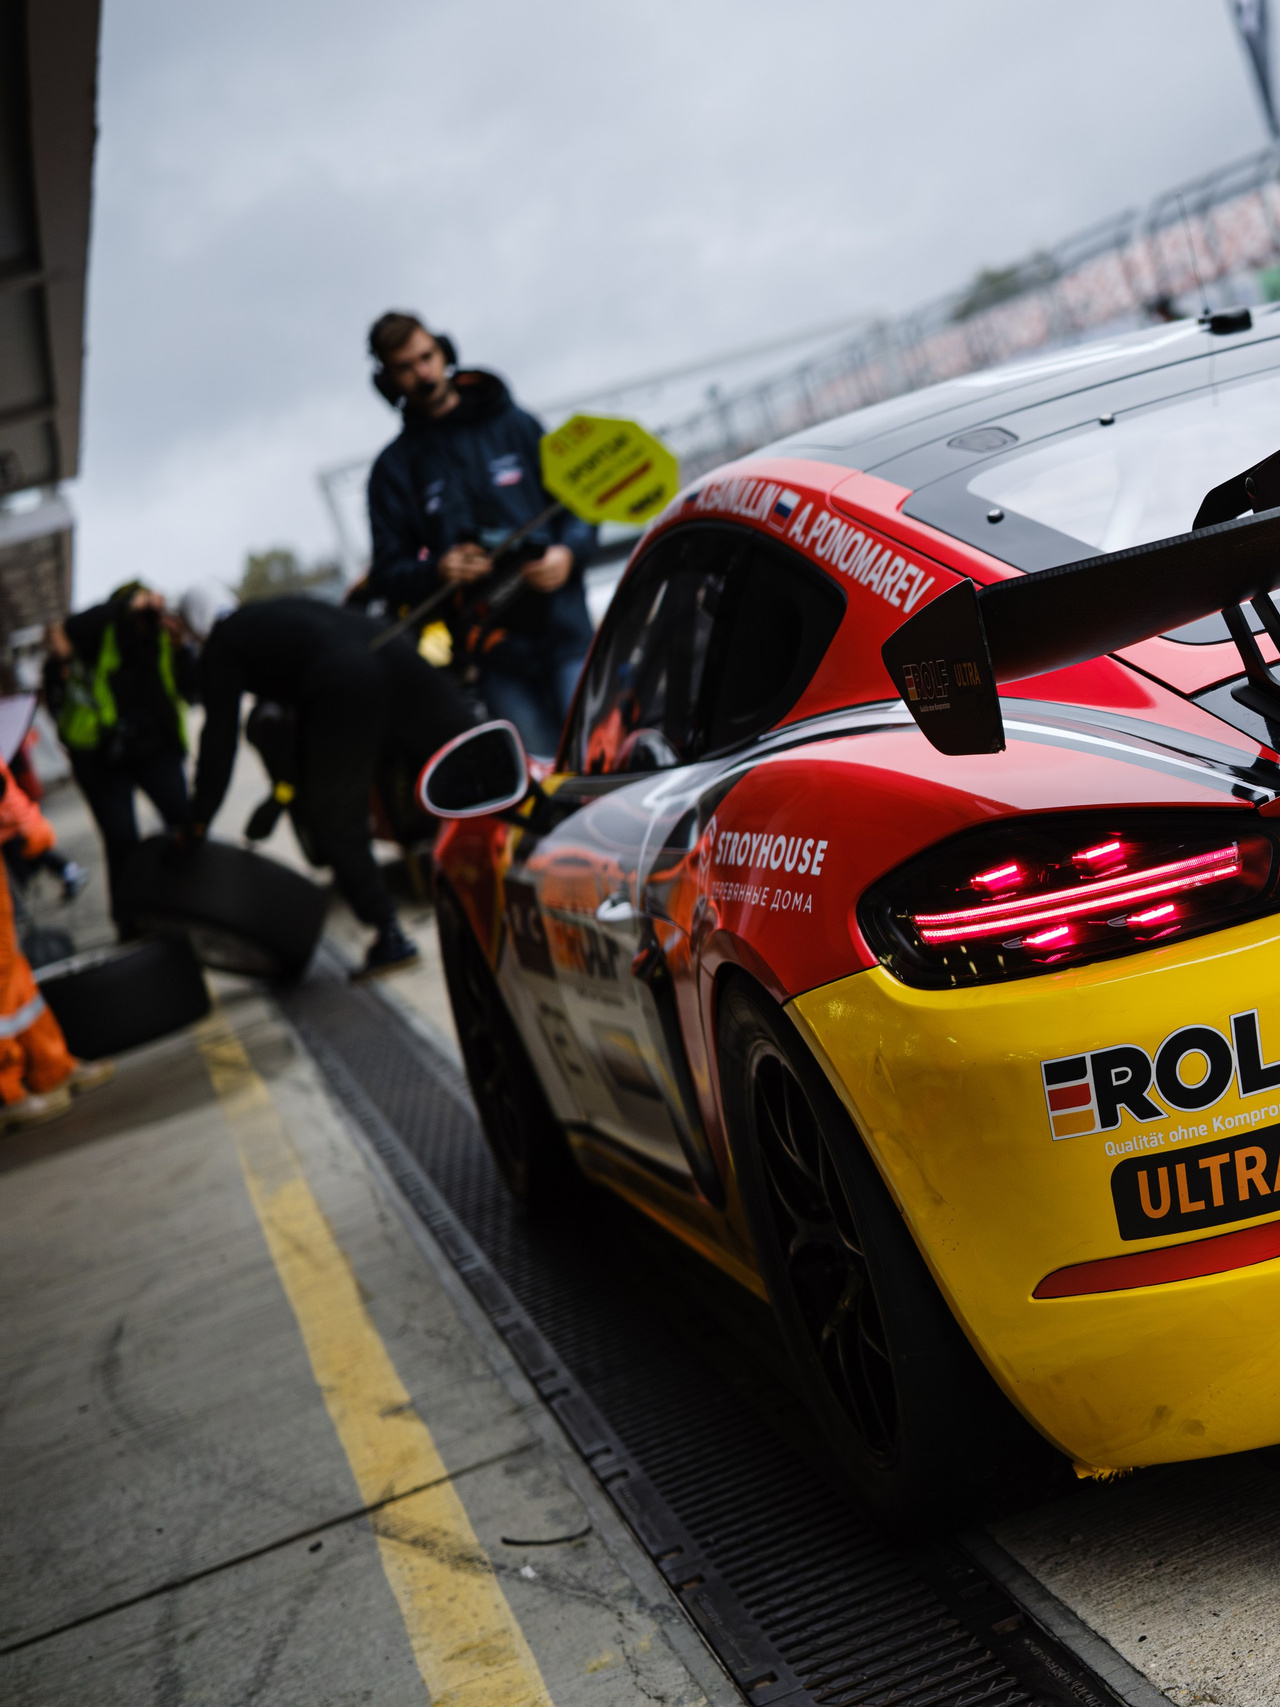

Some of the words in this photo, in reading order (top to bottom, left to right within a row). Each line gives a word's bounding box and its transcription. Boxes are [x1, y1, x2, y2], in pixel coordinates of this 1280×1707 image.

[954, 661, 981, 687] ULTRA
[715, 831, 828, 876] STROYHOUSE
[770, 889, 812, 914] ДОМА
[1104, 1132, 1165, 1157] Qualität
[1169, 1120, 1208, 1142] ohne
